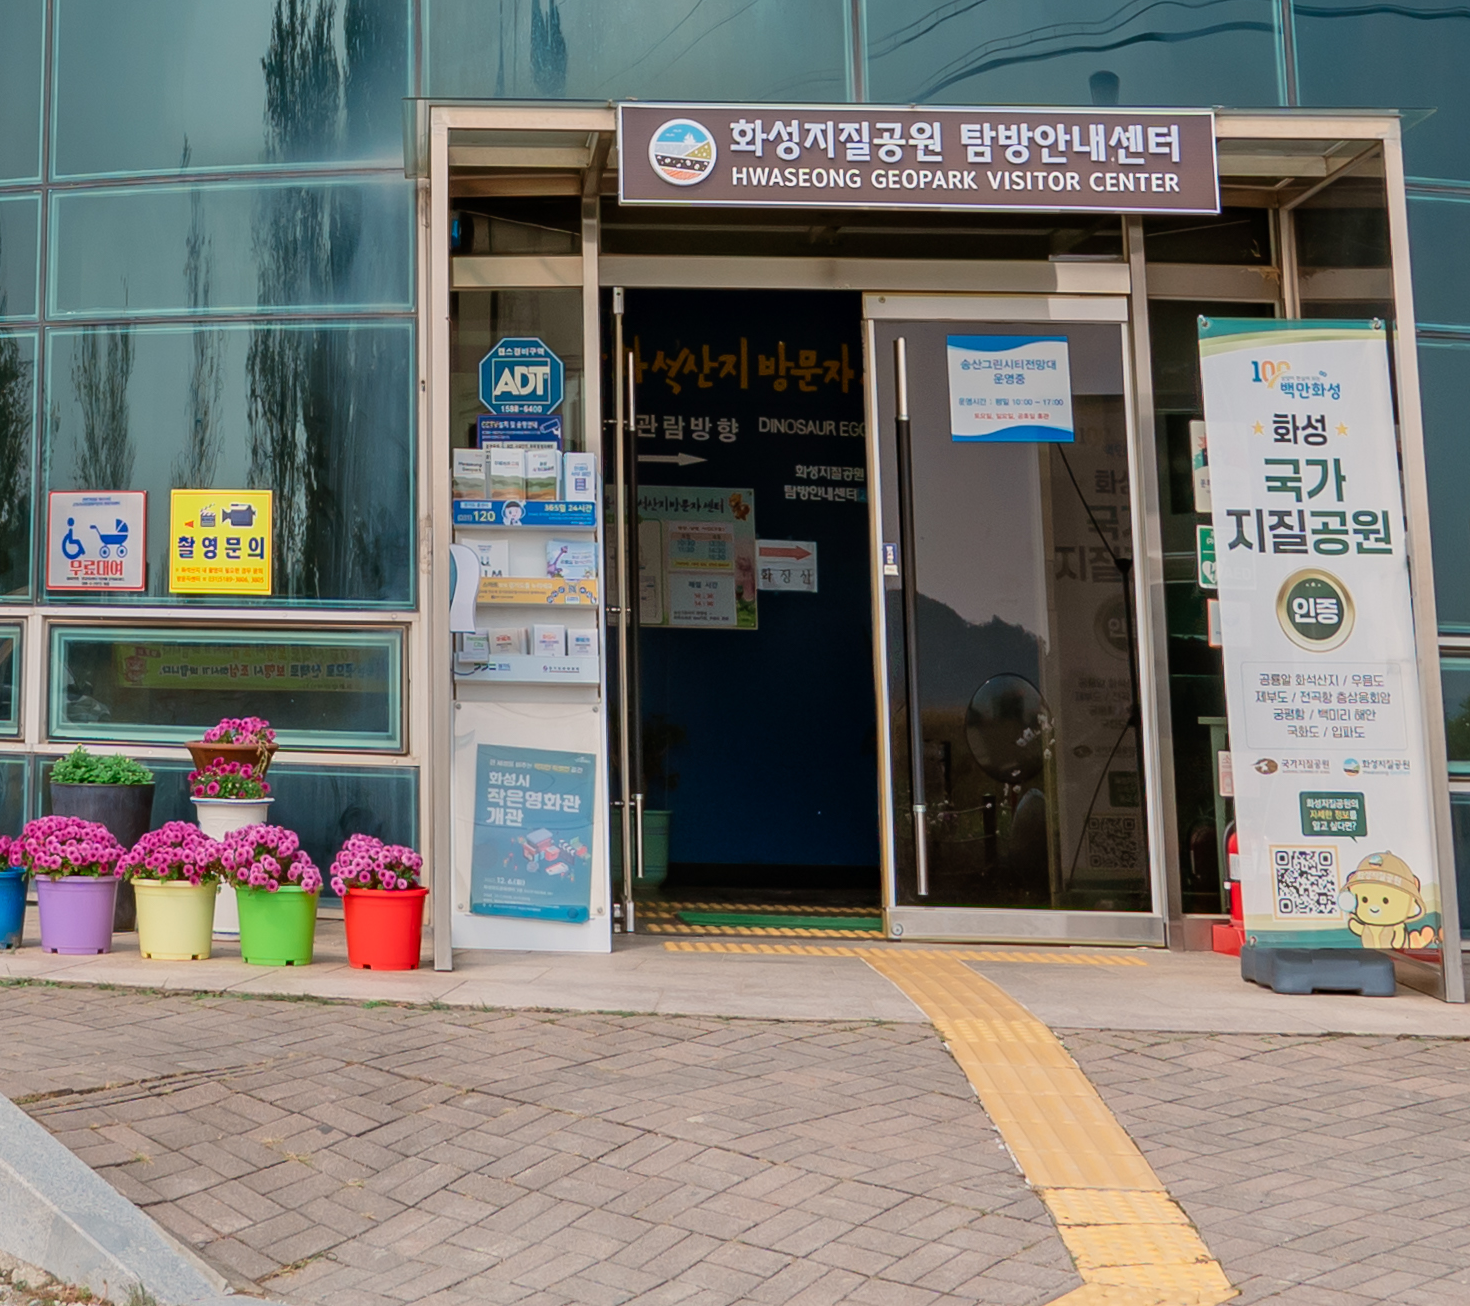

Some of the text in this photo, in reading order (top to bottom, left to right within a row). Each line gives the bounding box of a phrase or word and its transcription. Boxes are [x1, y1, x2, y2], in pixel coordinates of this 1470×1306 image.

[729, 119, 1181, 165] 화성지질공원 탐방안내센터
[731, 168, 1180, 193] HWASEONG GEOPARK VISITOR CENTER
[758, 340, 864, 394] 방문자
[960, 359, 1057, 371] 송산그린시티전망대
[493, 365, 550, 396] ADT
[993, 373, 1025, 385] 운영중
[1280, 382, 1341, 400] 백만화성
[500, 405, 543, 414] 1588-6400
[958, 398, 987, 406] 운영시간
[995, 398, 1010, 406] 평일
[1012, 398, 1033, 406] 10:00
[1042, 398, 1064, 406] 17:00
[758, 417, 836, 437] DINOSAUR
[1272, 413, 1328, 446] 화성
[795, 465, 865, 482] 화성지질공원
[1264, 457, 1347, 503] 국가
[784, 484, 858, 502] 탐방안내센터
[473, 510, 496, 522] 120
[1225, 508, 1394, 555] 지질공원
[178, 536, 265, 560] 촬영문의
[69, 560, 124, 576] 무료대여
[1292, 597, 1339, 624] 인증
[1259, 673, 1291, 686] 공룡알
[1295, 674, 1339, 686] 화석산지
[1352, 674, 1384, 687] 우음도
[1255, 690, 1288, 703] 제부도
[1300, 690, 1332, 704] 전곡항
[1273, 708, 1305, 721] 궁평항
[1318, 708, 1351, 721] 백미리
[1354, 708, 1376, 721] 해안
[1287, 725, 1320, 738] 국화도
[1331, 726, 1366, 738] 입파도
[1282, 759, 1330, 769] 국가지질공원
[1362, 760, 1410, 770] 화성지질공원
[489, 771, 530, 788] 화성시
[488, 788, 581, 813] 작은영화관
[1306, 798, 1360, 810] 화성지질공원의
[486, 807, 524, 827] 개관
[1330, 821, 1358, 832] 싶다면?
